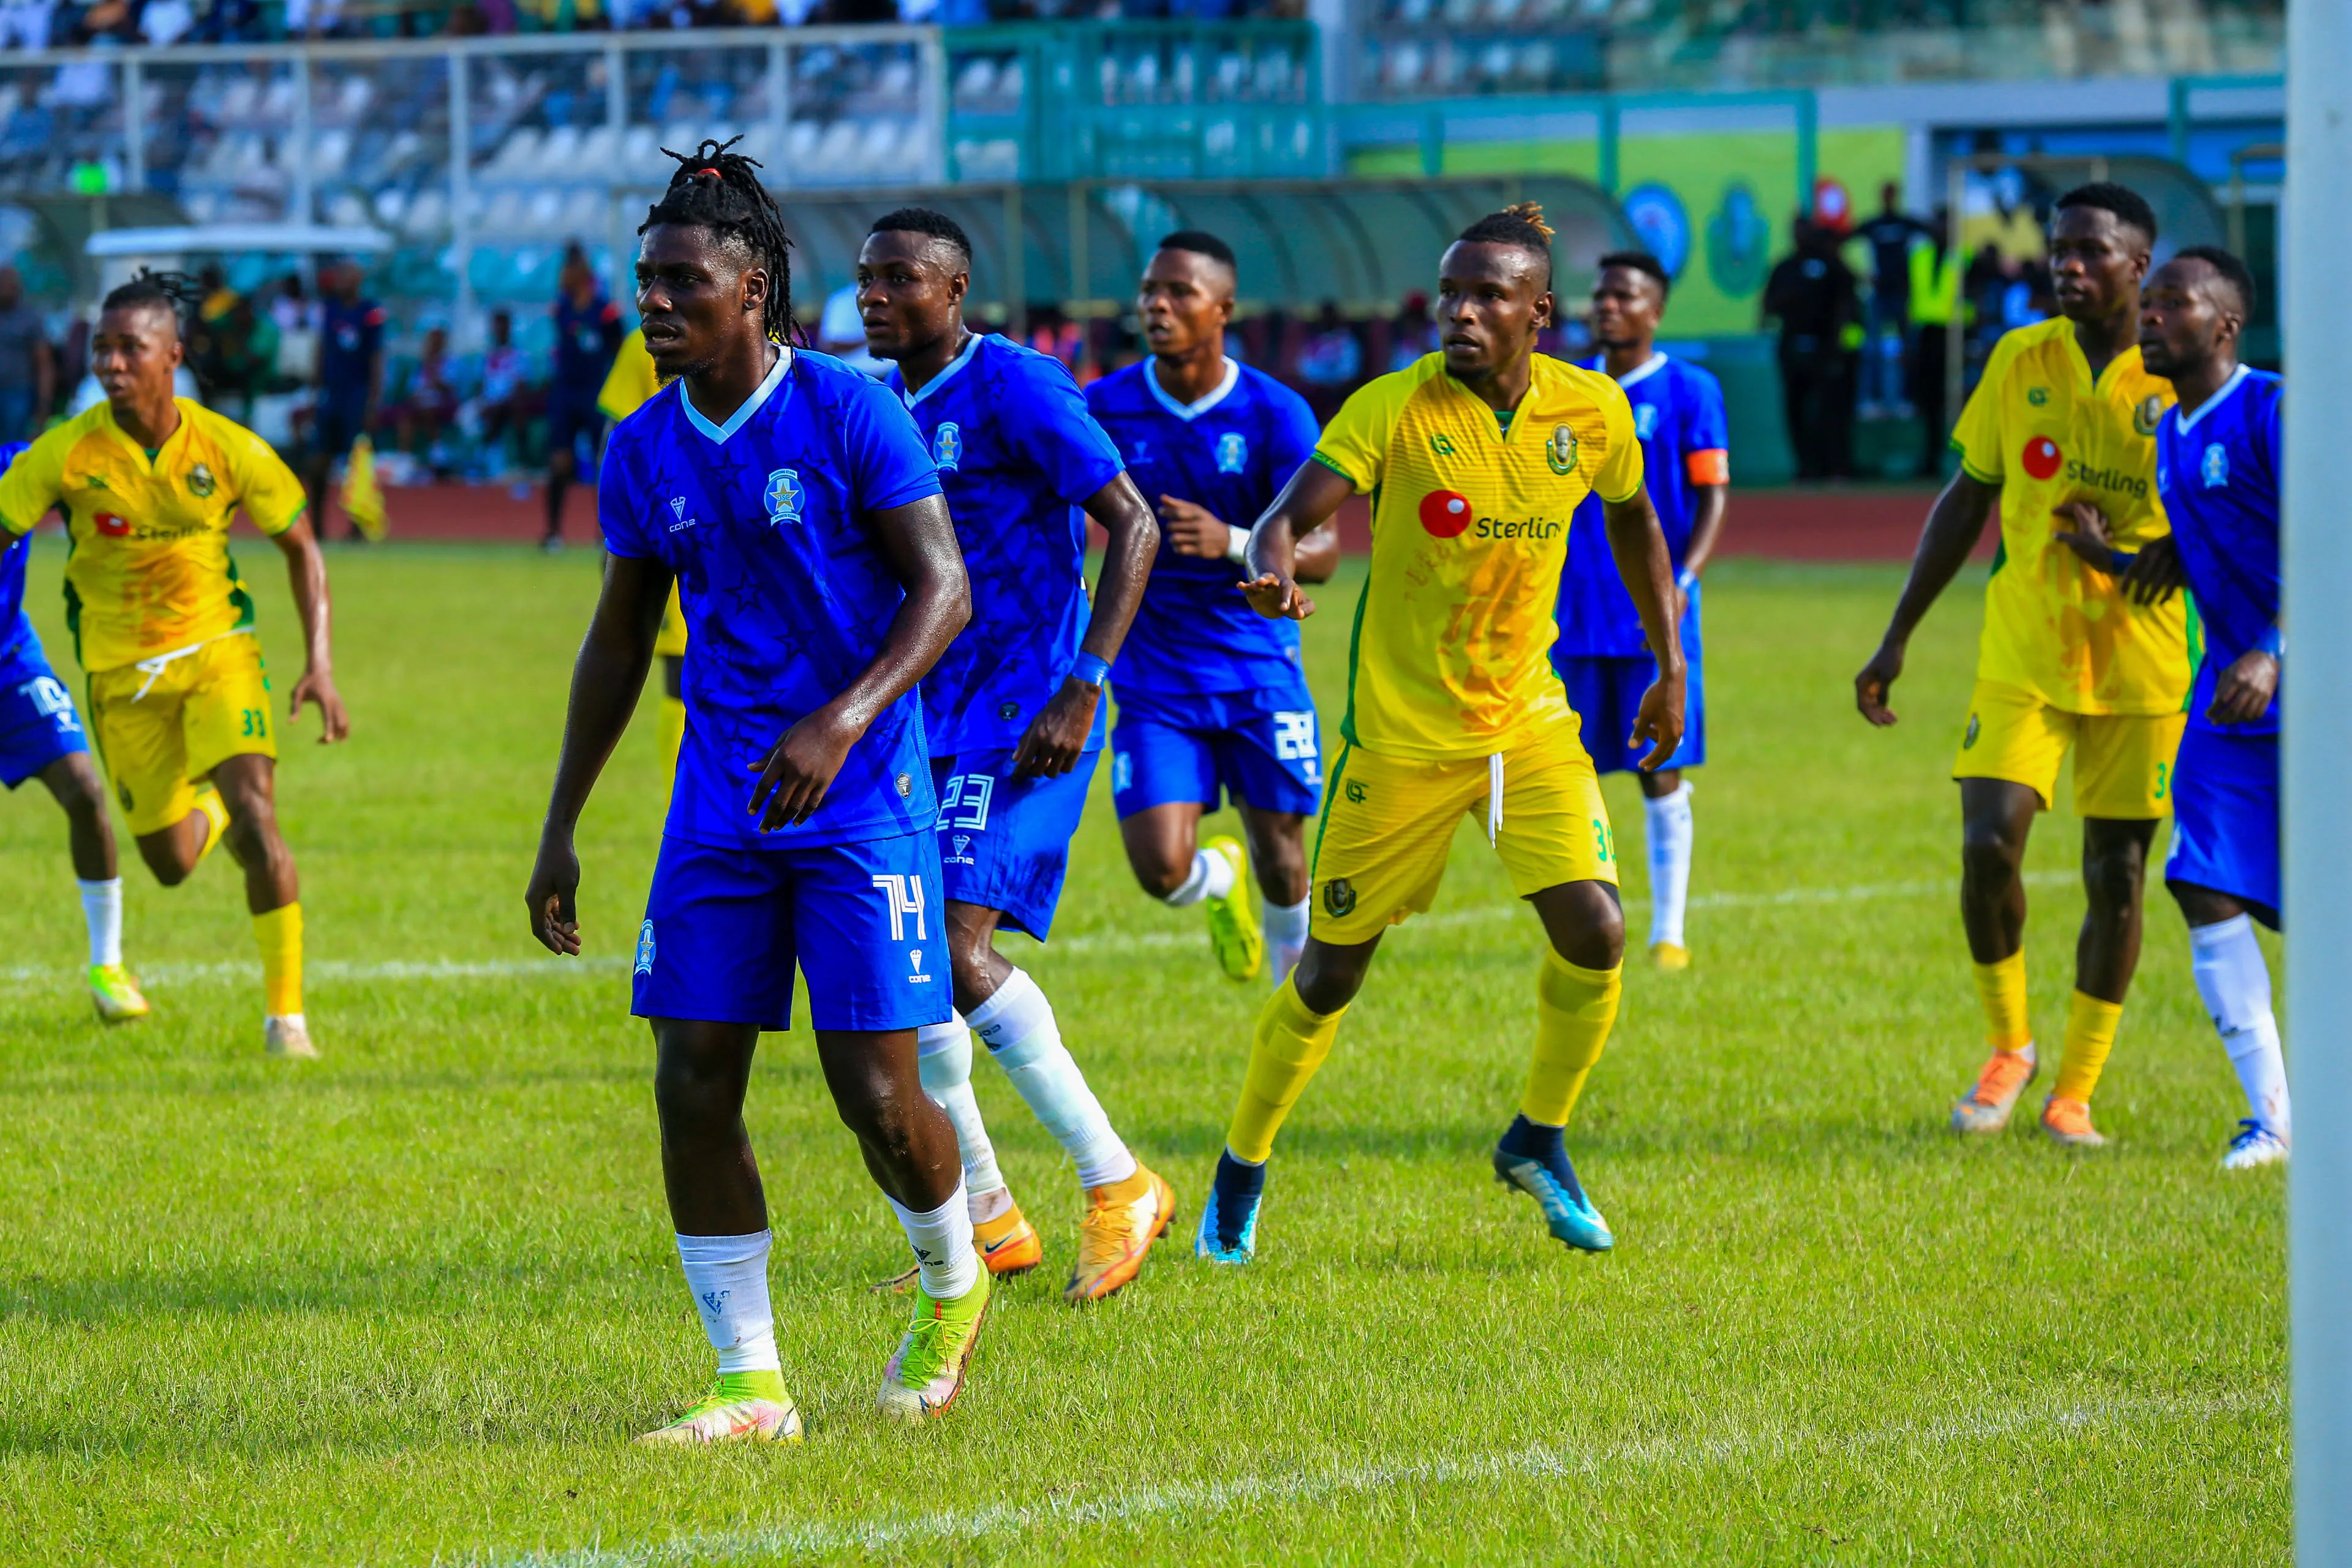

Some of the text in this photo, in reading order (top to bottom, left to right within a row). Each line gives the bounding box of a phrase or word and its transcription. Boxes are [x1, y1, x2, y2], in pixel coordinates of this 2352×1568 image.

[669, 519, 696, 532] cone
[1476, 516, 1565, 539] Sterlin
[935, 774, 995, 831] 23
[943, 856, 975, 865] cone
[908, 974, 931, 983] cone
